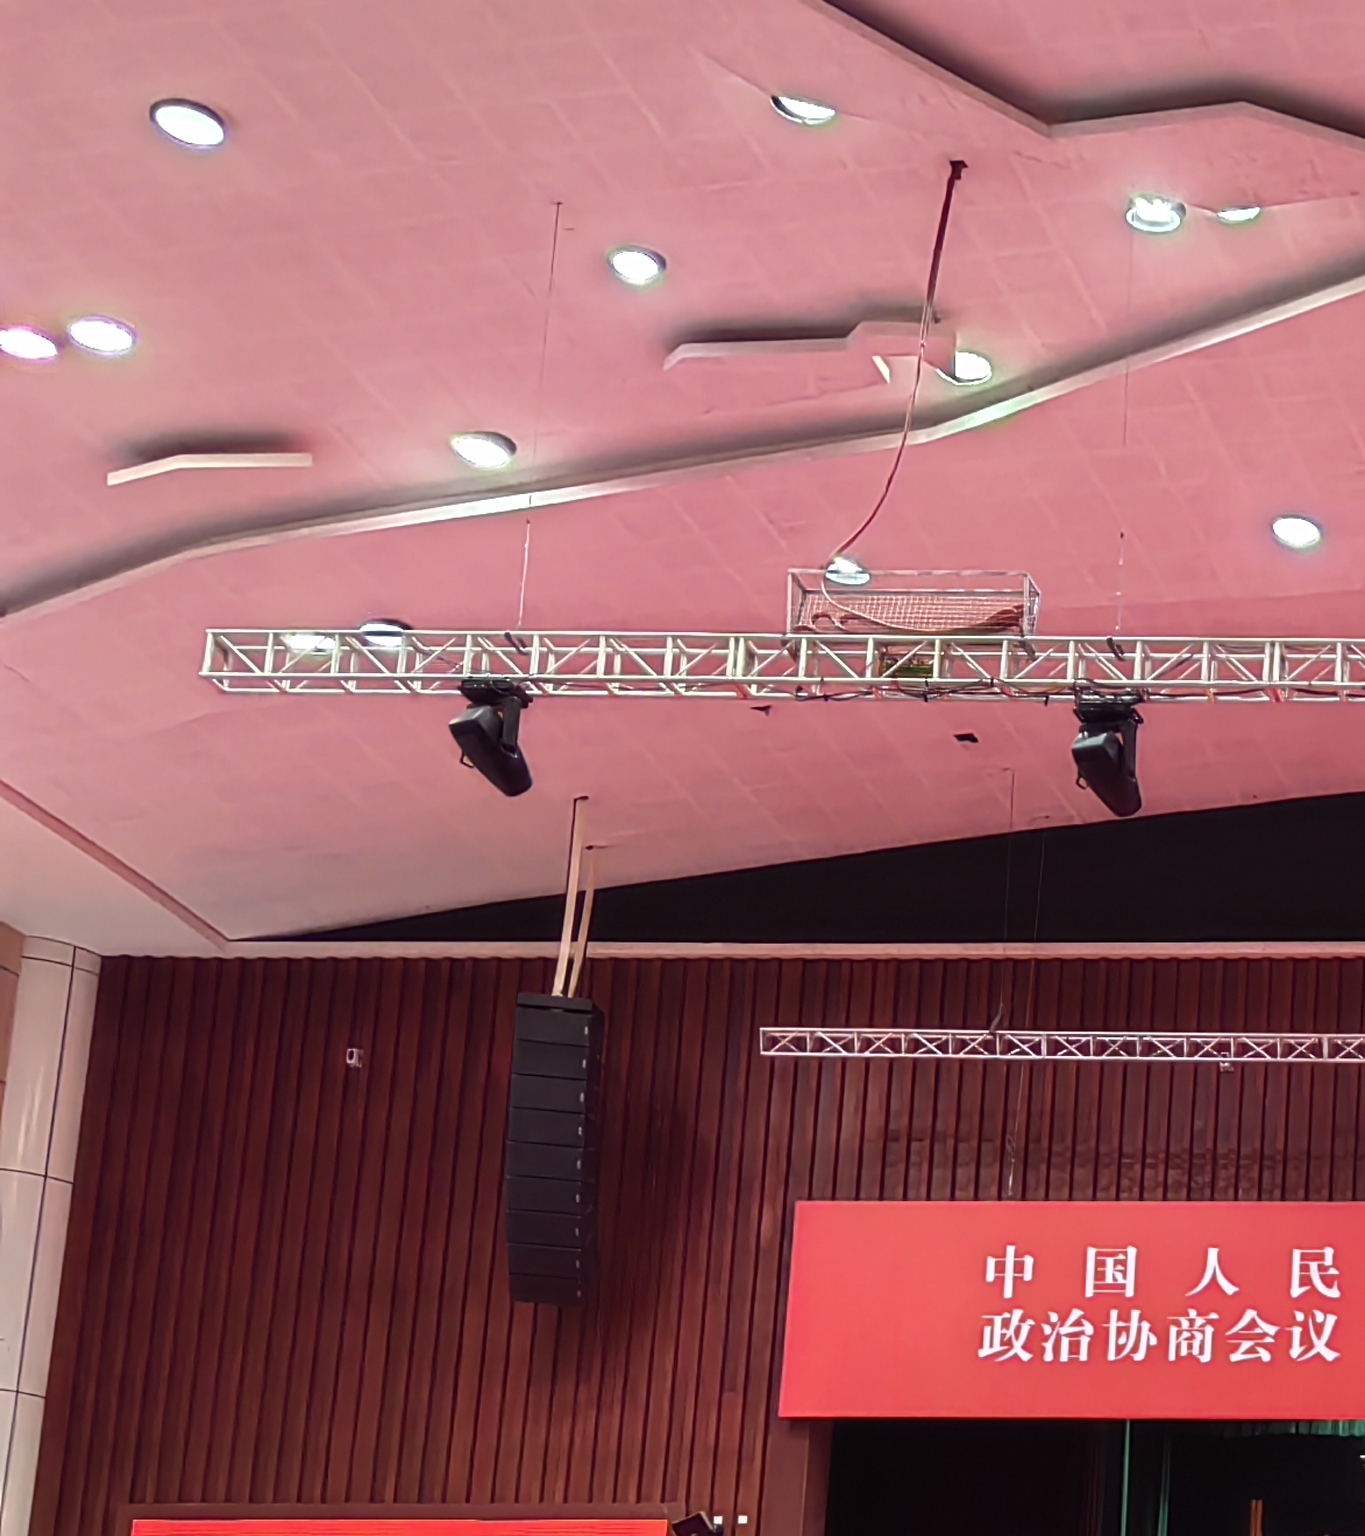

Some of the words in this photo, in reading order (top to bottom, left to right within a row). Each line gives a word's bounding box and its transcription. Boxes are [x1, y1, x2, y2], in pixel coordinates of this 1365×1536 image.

[984, 1245, 1342, 1299] 中国人民
[977, 1308, 1341, 1363] 政治协商会议
